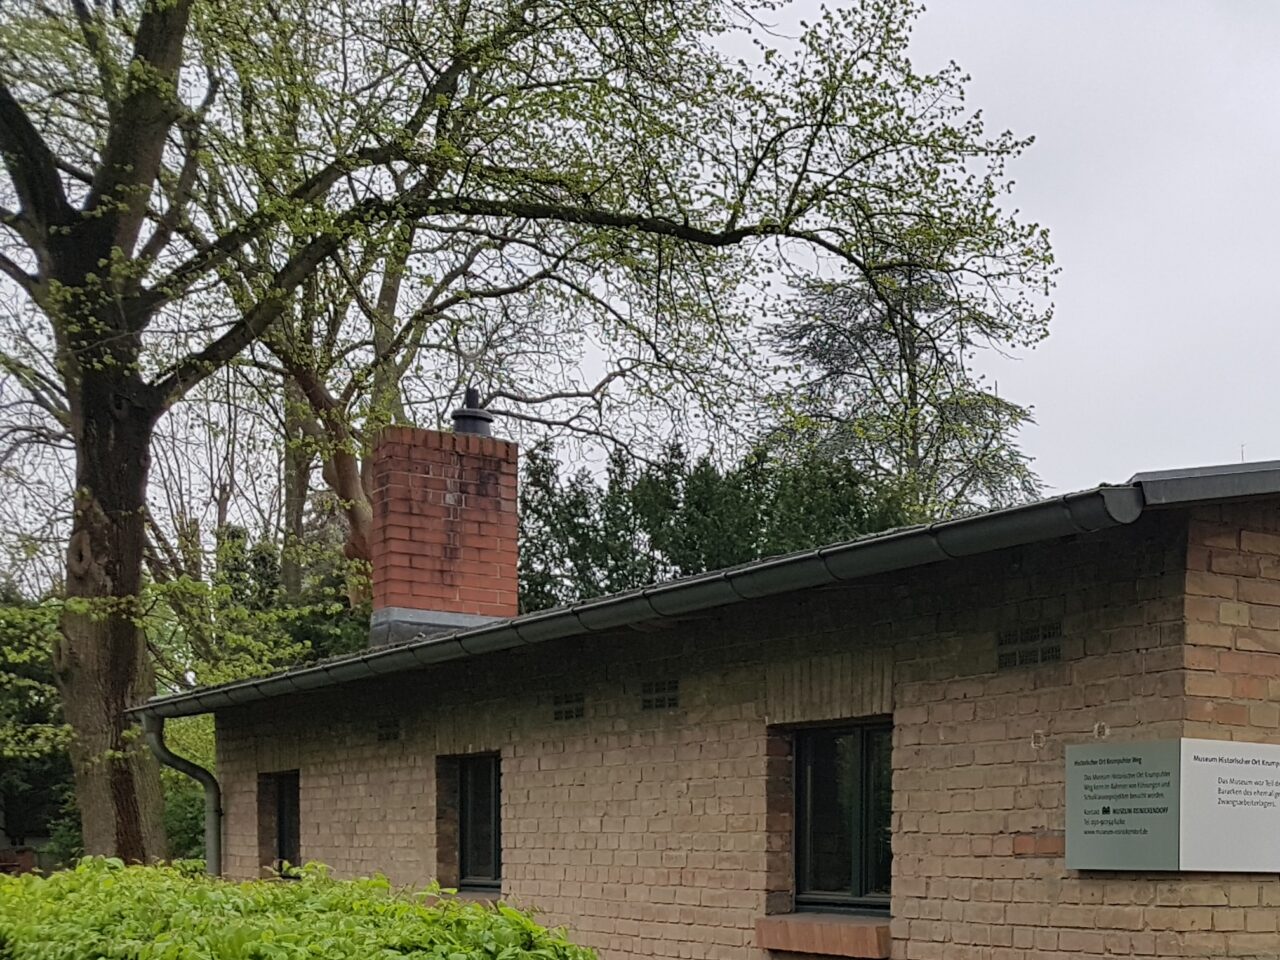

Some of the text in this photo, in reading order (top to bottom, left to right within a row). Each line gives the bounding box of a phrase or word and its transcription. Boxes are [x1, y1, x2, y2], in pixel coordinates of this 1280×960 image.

[1132, 757, 1142, 765] Weg
[1218, 756, 1250, 765] Historischer
[1229, 778, 1253, 786] Museum
[1265, 779, 1274, 787] Teil
[1218, 787, 1242, 795] Baracken
[1243, 788, 1253, 796] des
